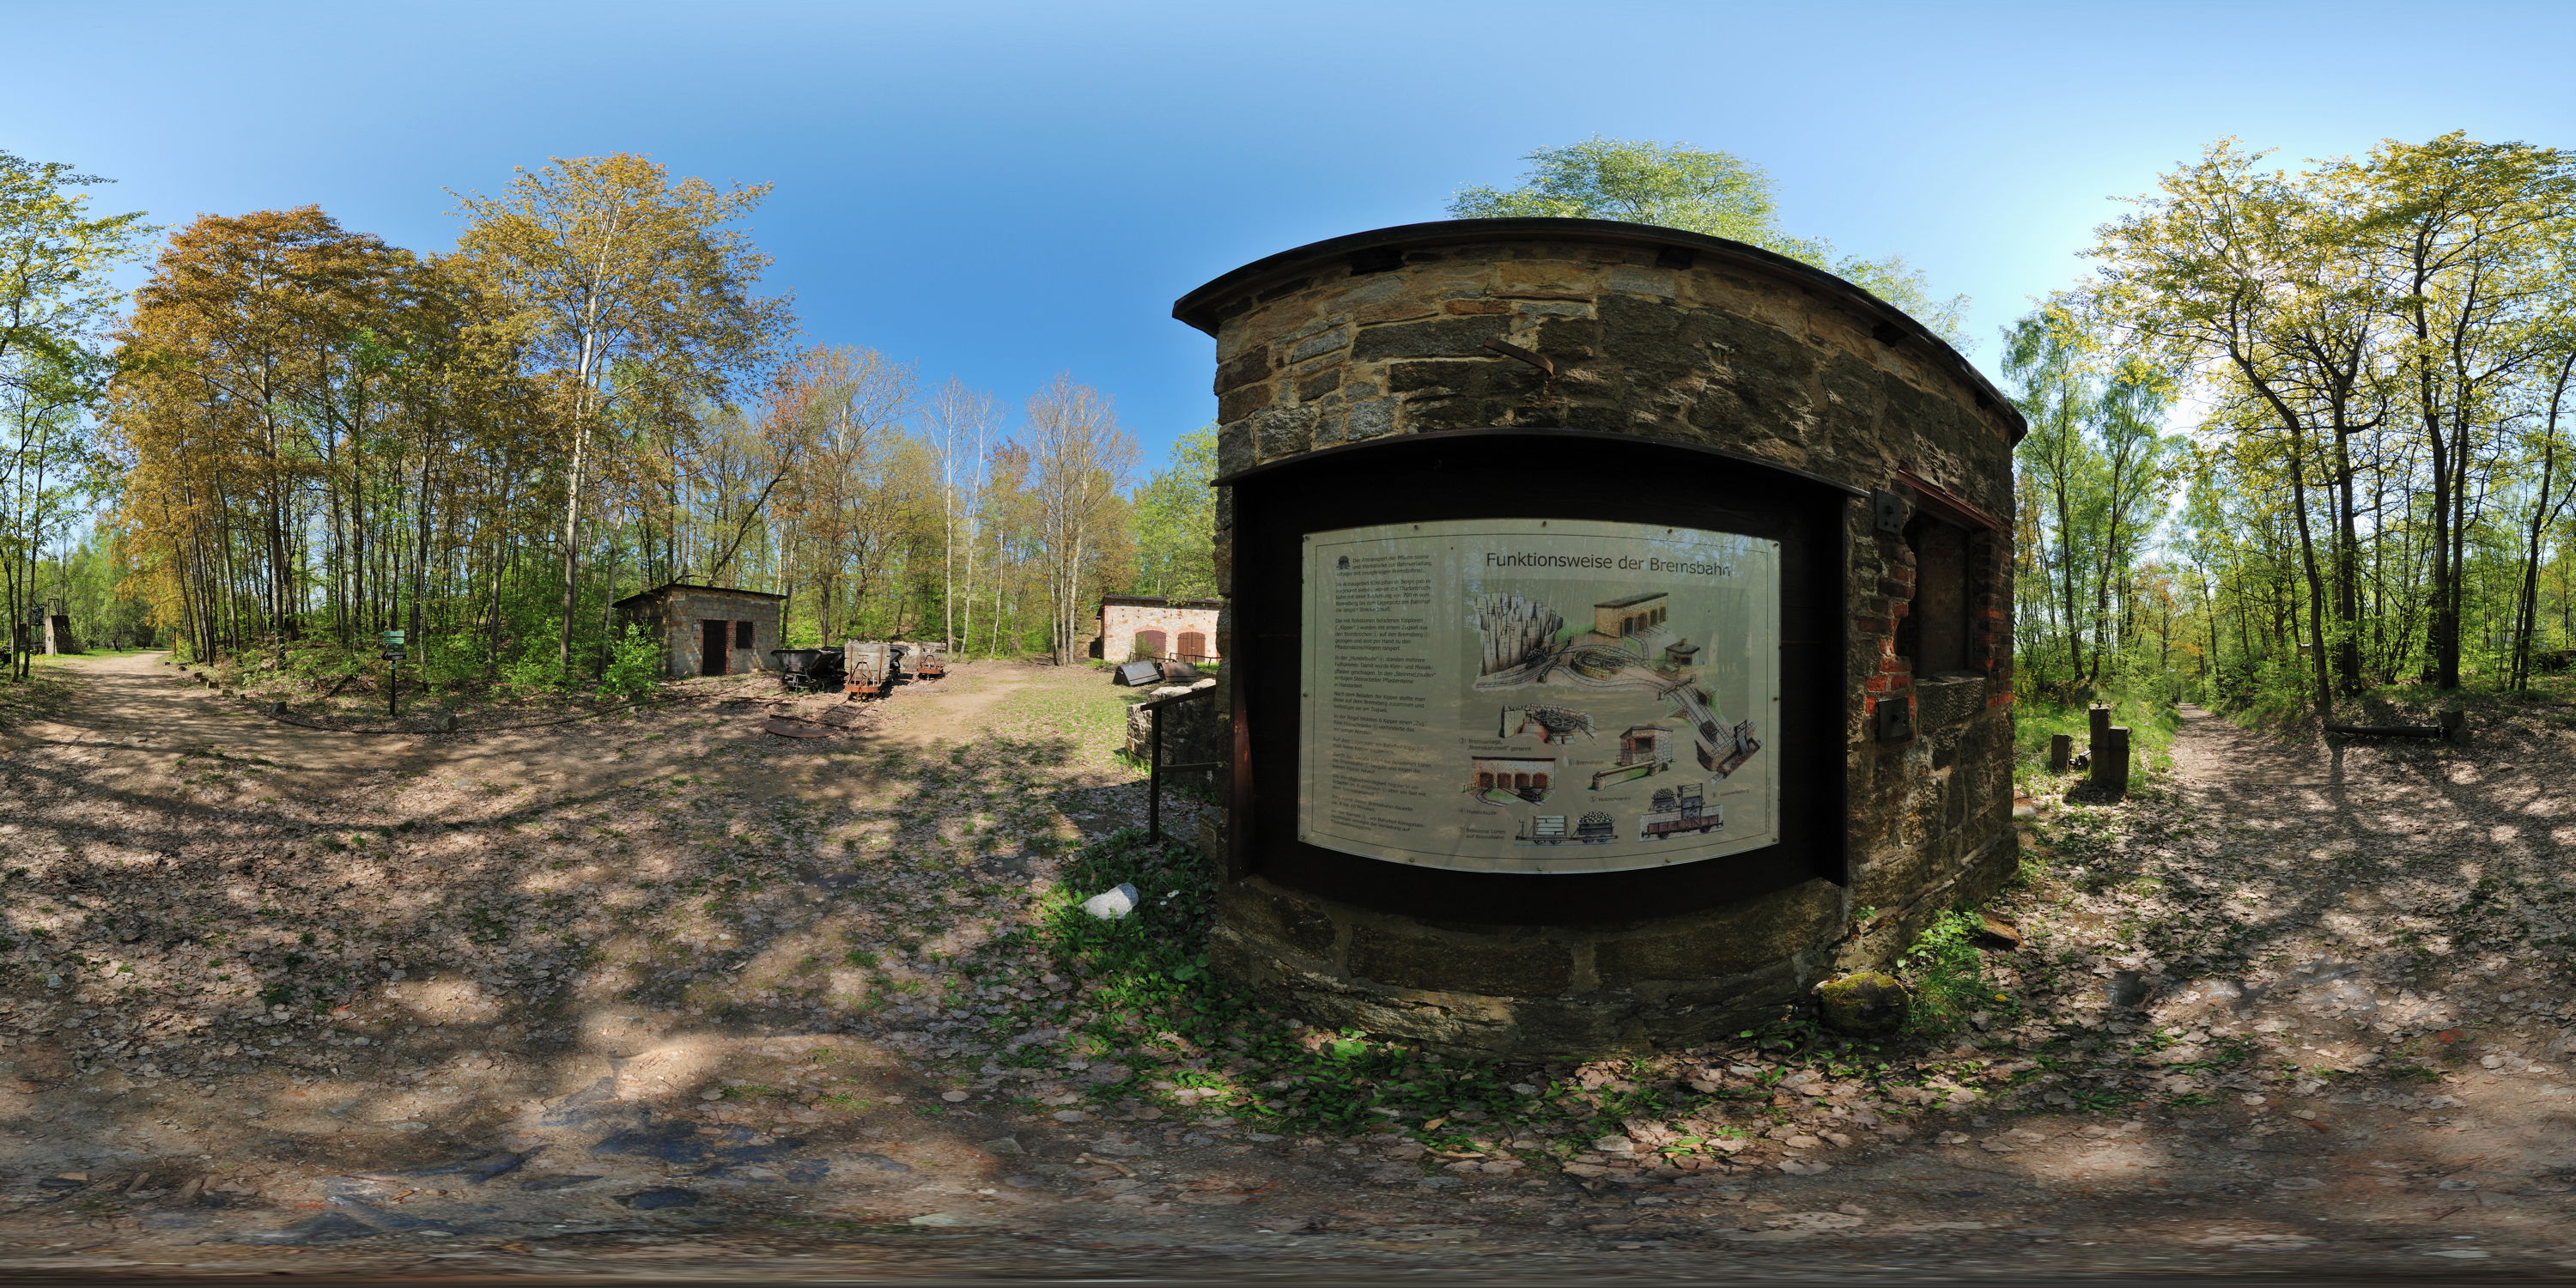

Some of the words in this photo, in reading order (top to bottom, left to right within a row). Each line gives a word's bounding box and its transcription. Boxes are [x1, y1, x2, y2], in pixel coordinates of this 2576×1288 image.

[1487, 552, 1612, 569] Funktionsweise
[1619, 556, 1643, 570] der
[1650, 557, 1730, 577] Bremsbahn
